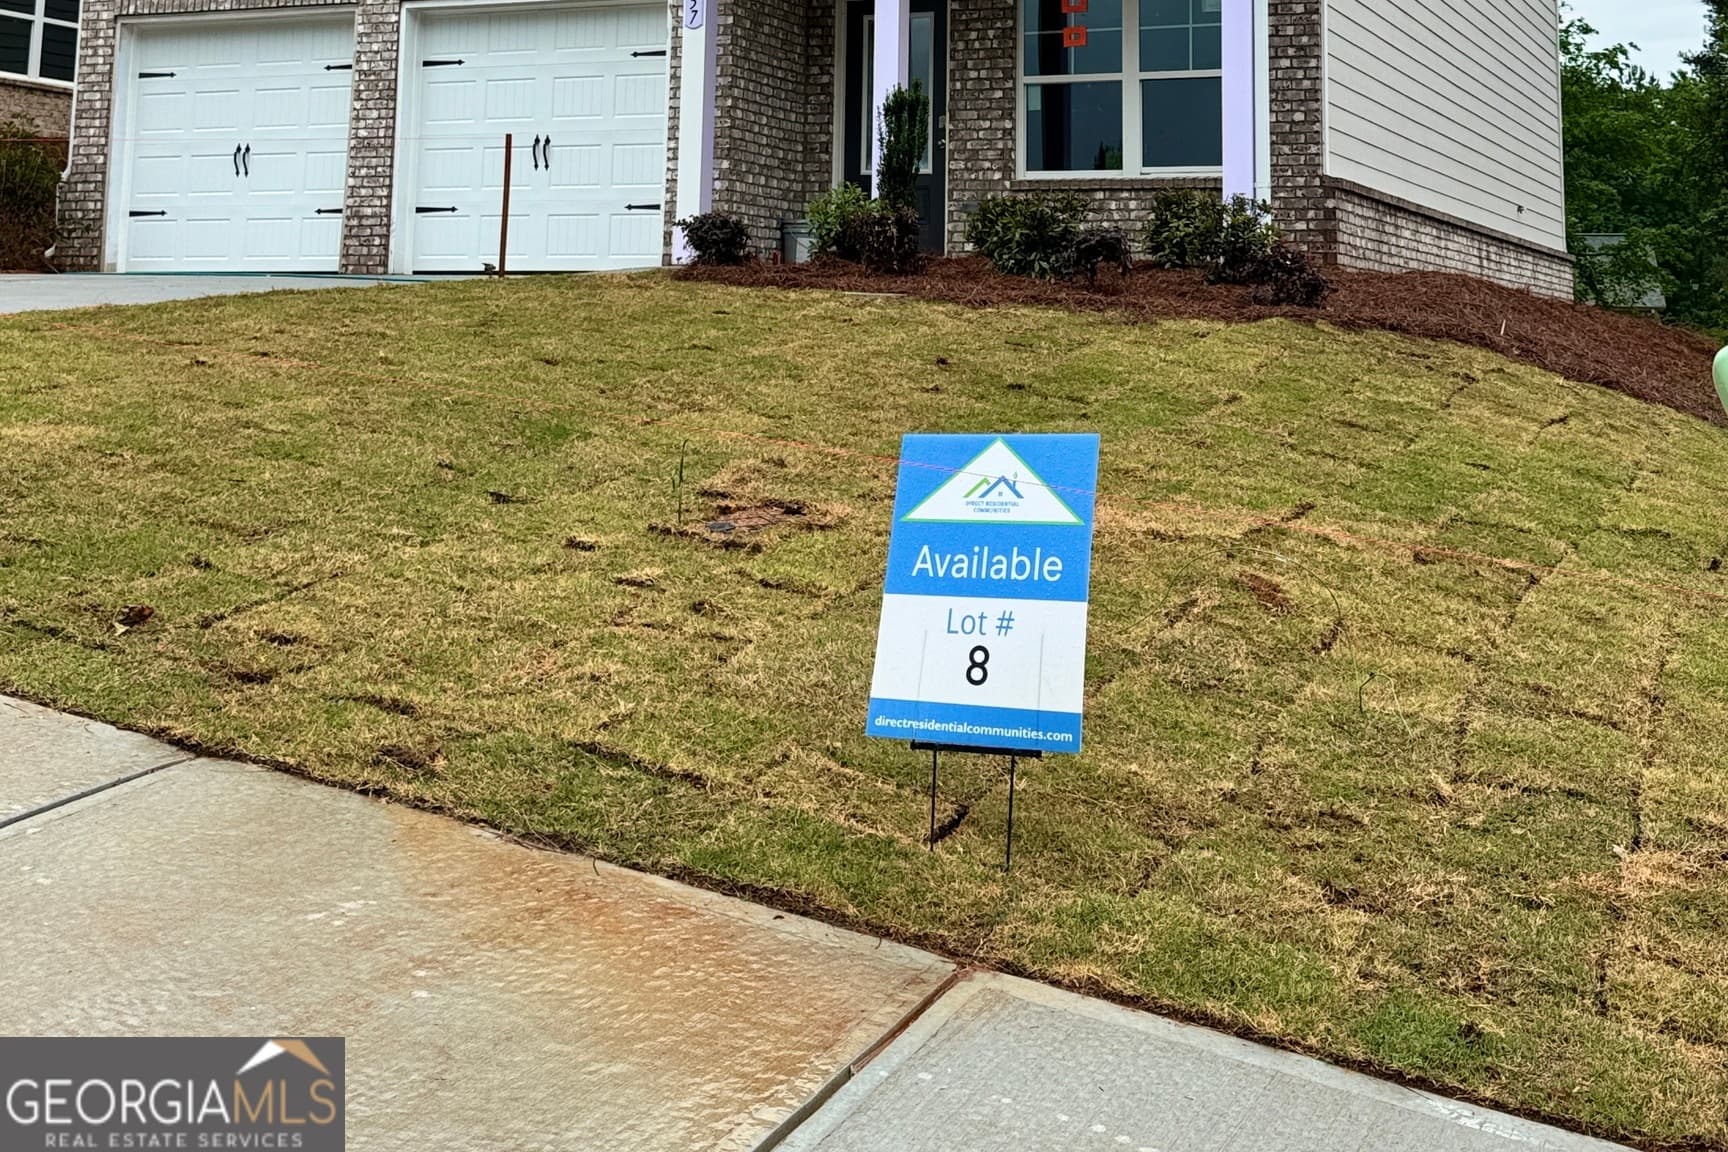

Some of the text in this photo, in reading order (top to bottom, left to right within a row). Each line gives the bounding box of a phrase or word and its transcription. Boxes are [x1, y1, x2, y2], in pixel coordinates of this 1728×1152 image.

[911, 544, 1063, 582] Available
[946, 608, 1015, 637] Lot #
[965, 645, 990, 686] 8
[874, 715, 1073, 742] directresidentialcommunities.com
